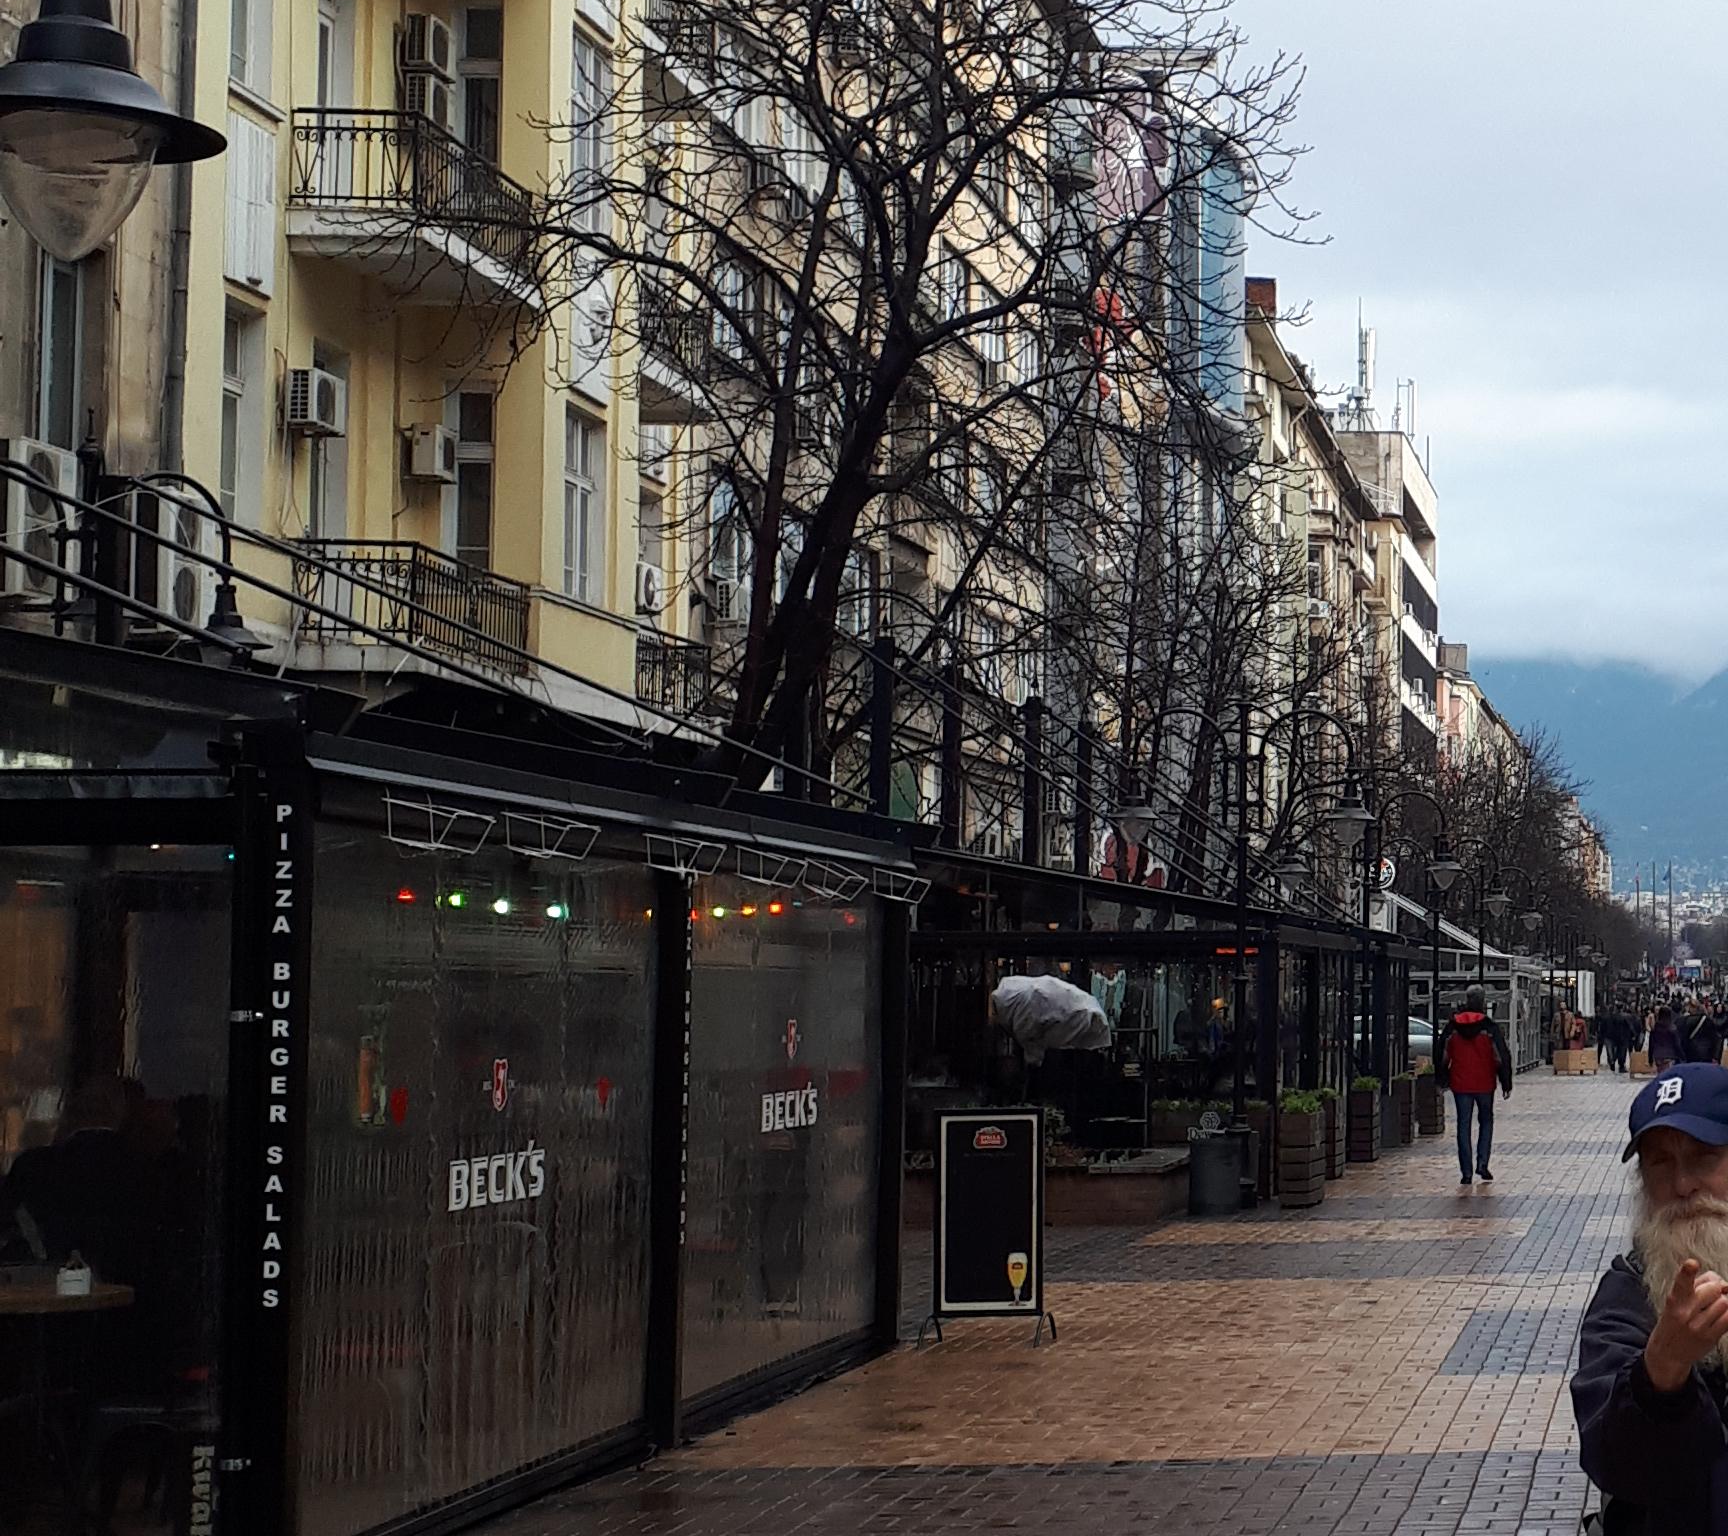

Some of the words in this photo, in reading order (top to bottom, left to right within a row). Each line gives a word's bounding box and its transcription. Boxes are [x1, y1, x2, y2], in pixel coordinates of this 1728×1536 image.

[271, 803, 293, 934] PIZZA
[268, 962, 291, 1122] BURGER
[761, 1081, 817, 1134] BECK'S
[262, 1145, 284, 1307] SALADS
[447, 1139, 546, 1212] BECK'S
